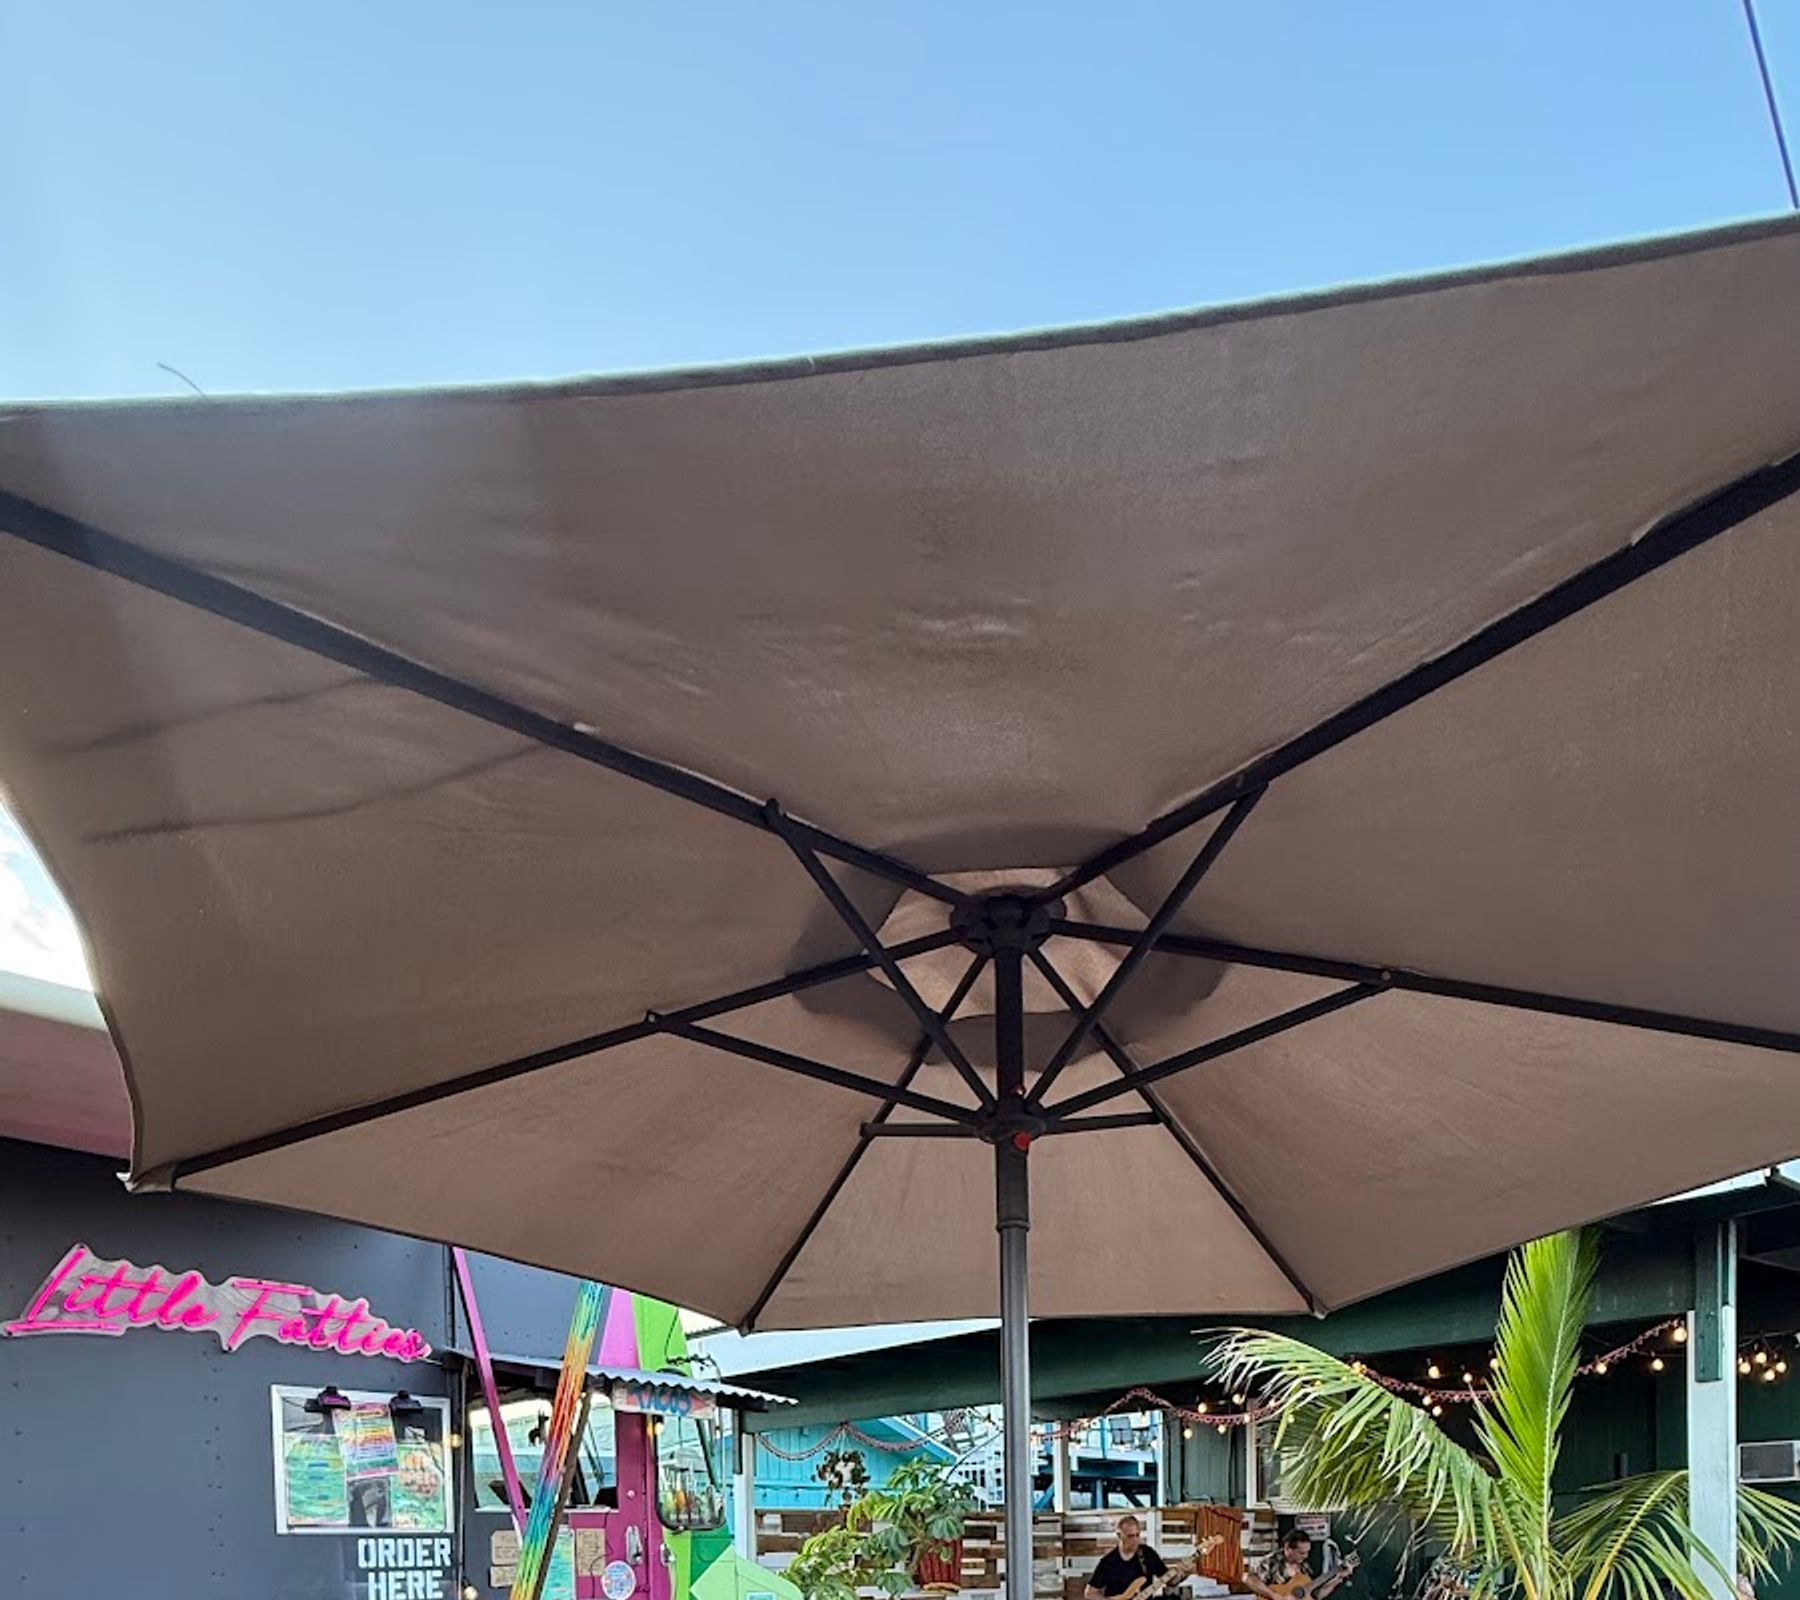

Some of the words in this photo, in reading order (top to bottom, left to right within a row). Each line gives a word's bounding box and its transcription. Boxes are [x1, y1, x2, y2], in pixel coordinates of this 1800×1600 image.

[4, 1247, 219, 1336] Little
[227, 1278, 431, 1360] Fatties
[358, 1537, 451, 1568] ORDER
[368, 1570, 443, 1600] HERE
